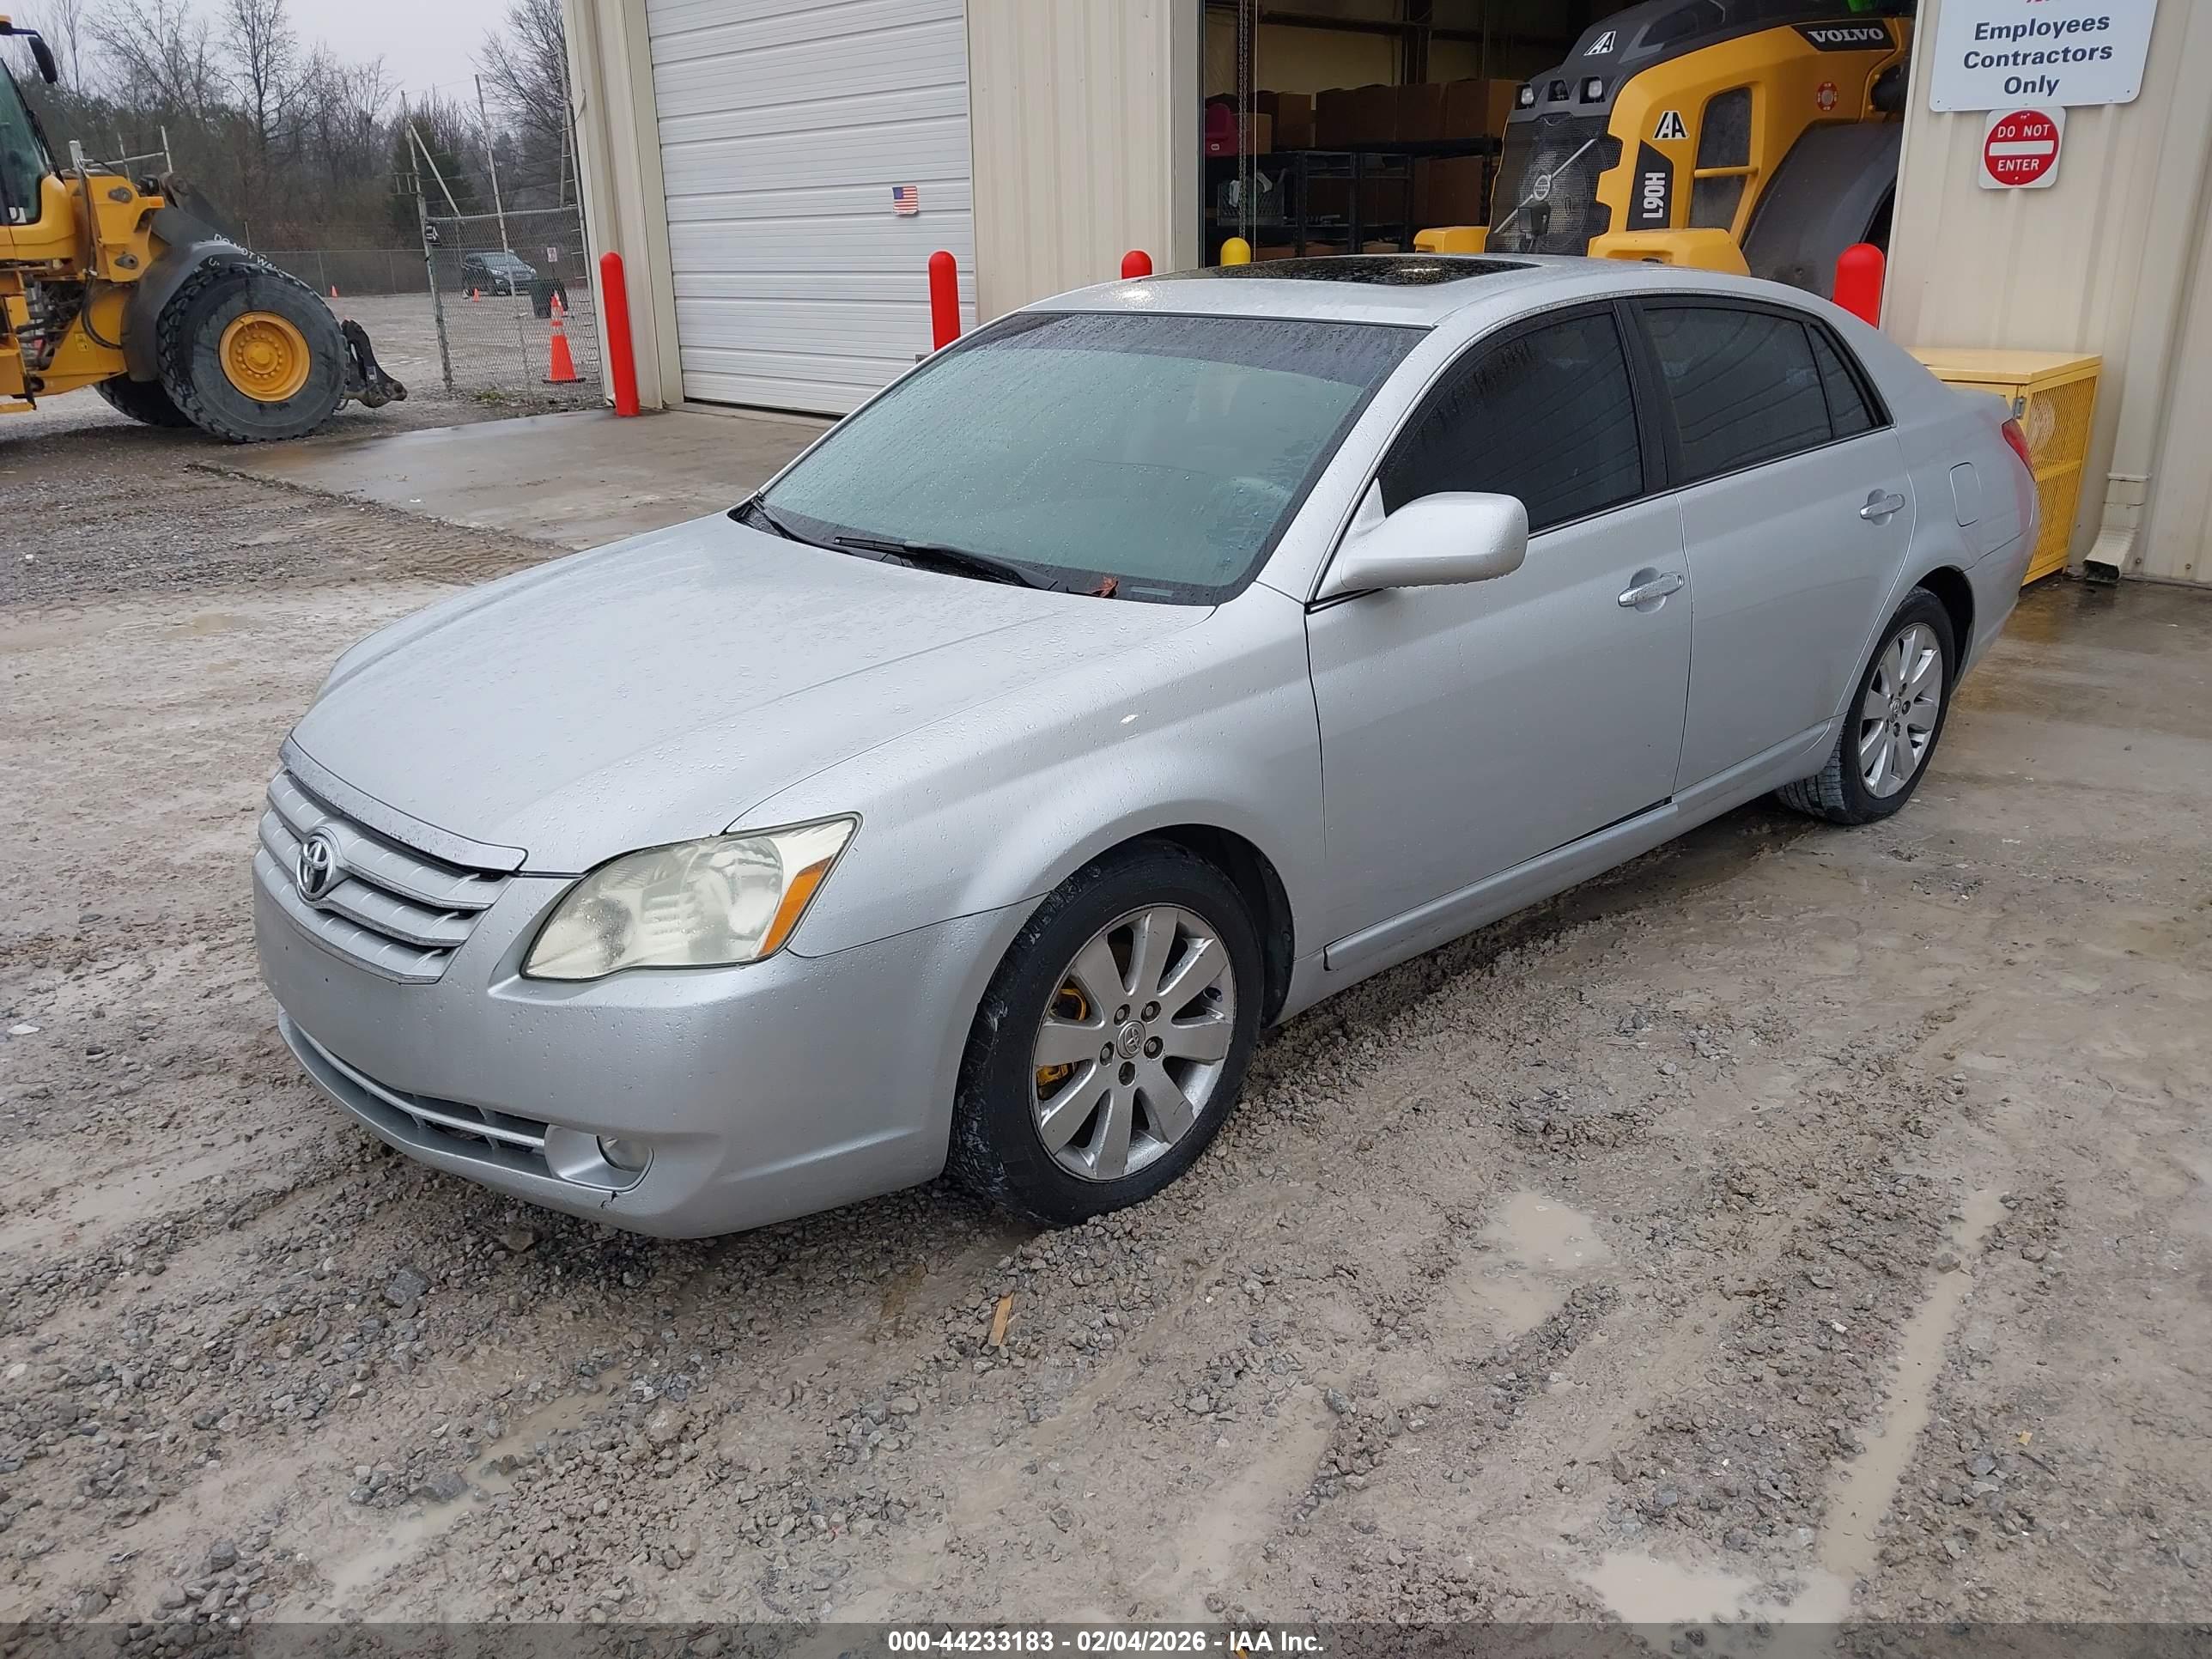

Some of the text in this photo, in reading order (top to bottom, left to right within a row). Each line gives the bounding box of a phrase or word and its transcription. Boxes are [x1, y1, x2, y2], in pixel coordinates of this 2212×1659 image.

[1807, 27, 1884, 43] VOLVO
[1974, 15, 2112, 43] Employees
[1963, 45, 2113, 70] Contractors
[2003, 75, 2060, 97] Only
[1997, 124, 2051, 138] DO NOT
[1997, 158, 2039, 172] ENTER
[1642, 172, 1666, 218] L90H
